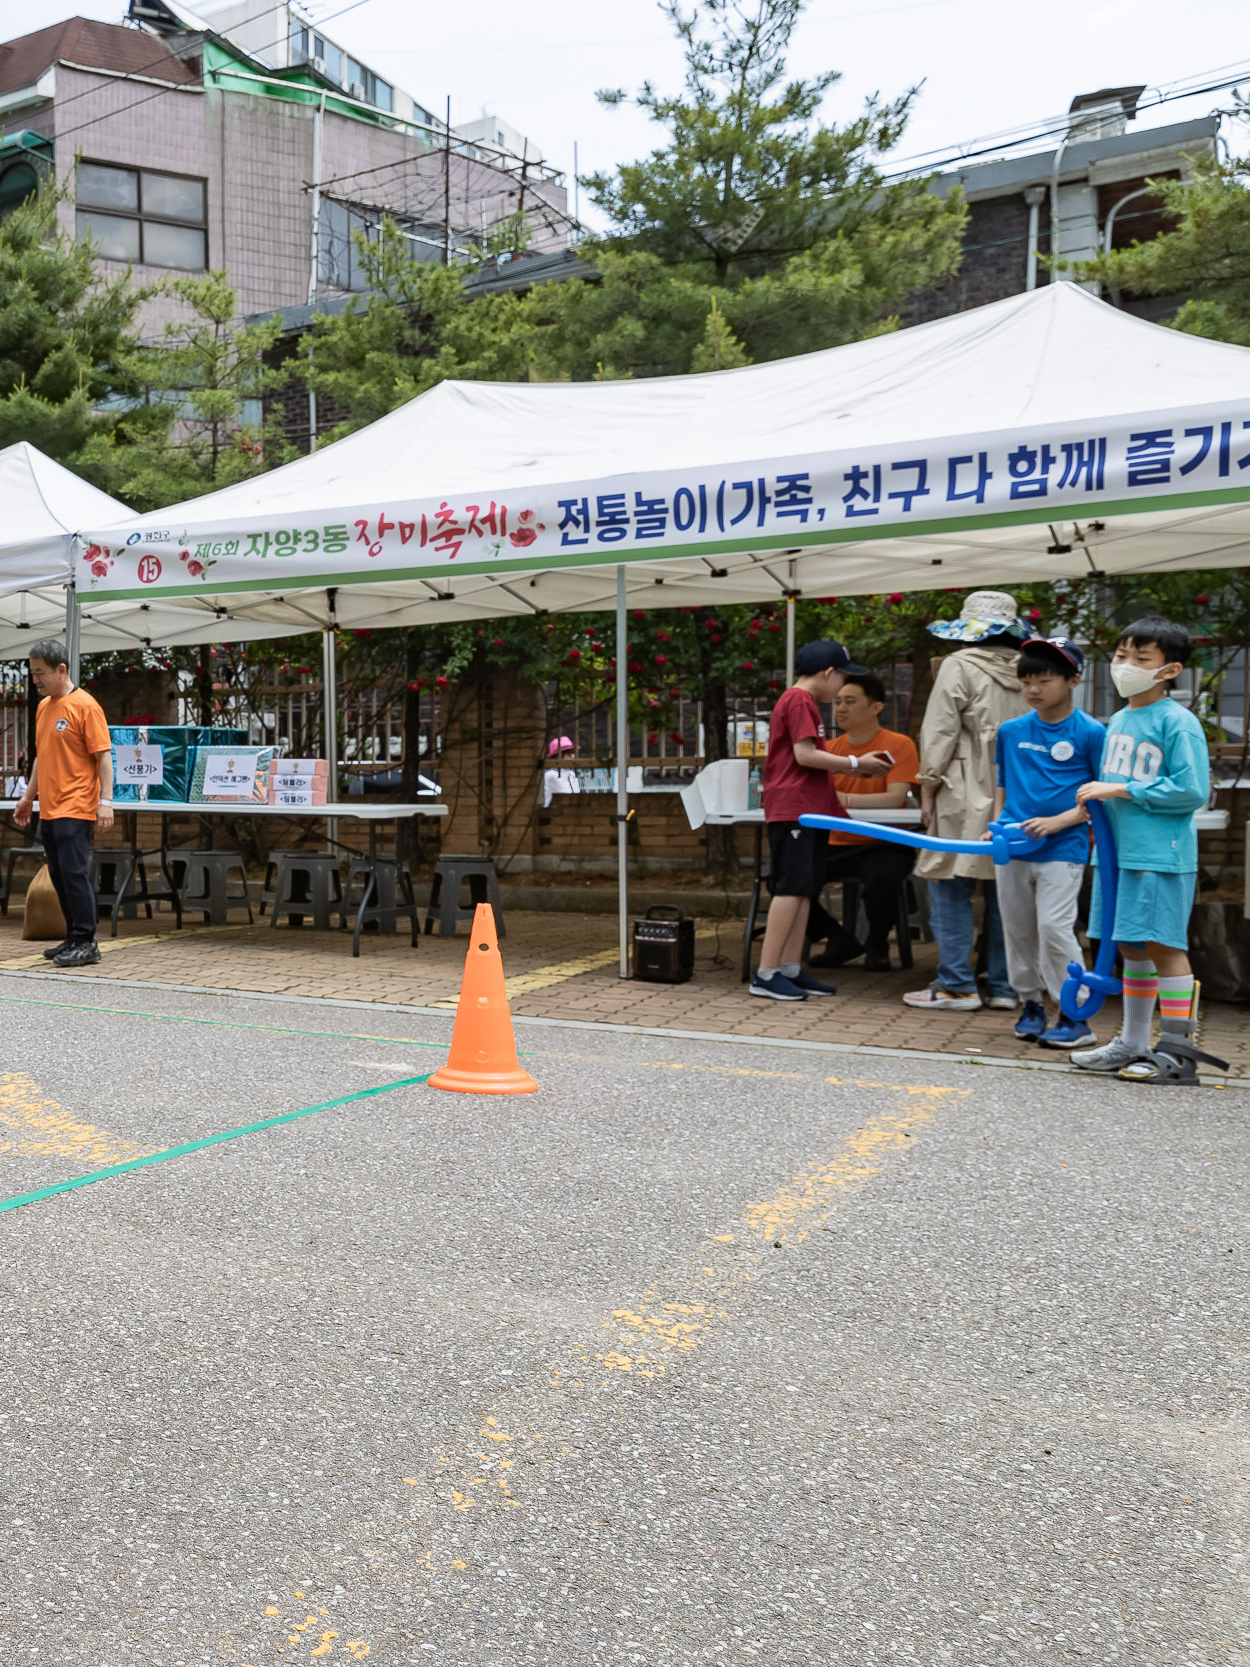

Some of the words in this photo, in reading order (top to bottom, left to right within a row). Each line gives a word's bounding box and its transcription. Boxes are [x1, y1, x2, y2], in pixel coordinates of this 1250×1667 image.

[194, 539, 240, 558] 제6회
[243, 523, 350, 558] 자양3동
[354, 500, 508, 559] 장미축제
[557, 472, 826, 546] 전통놀이(가족,
[842, 457, 931, 518] 친구
[946, 451, 993, 504] 다
[1007, 436, 1108, 501] 함께
[1126, 420, 1250, 488] 즐기
